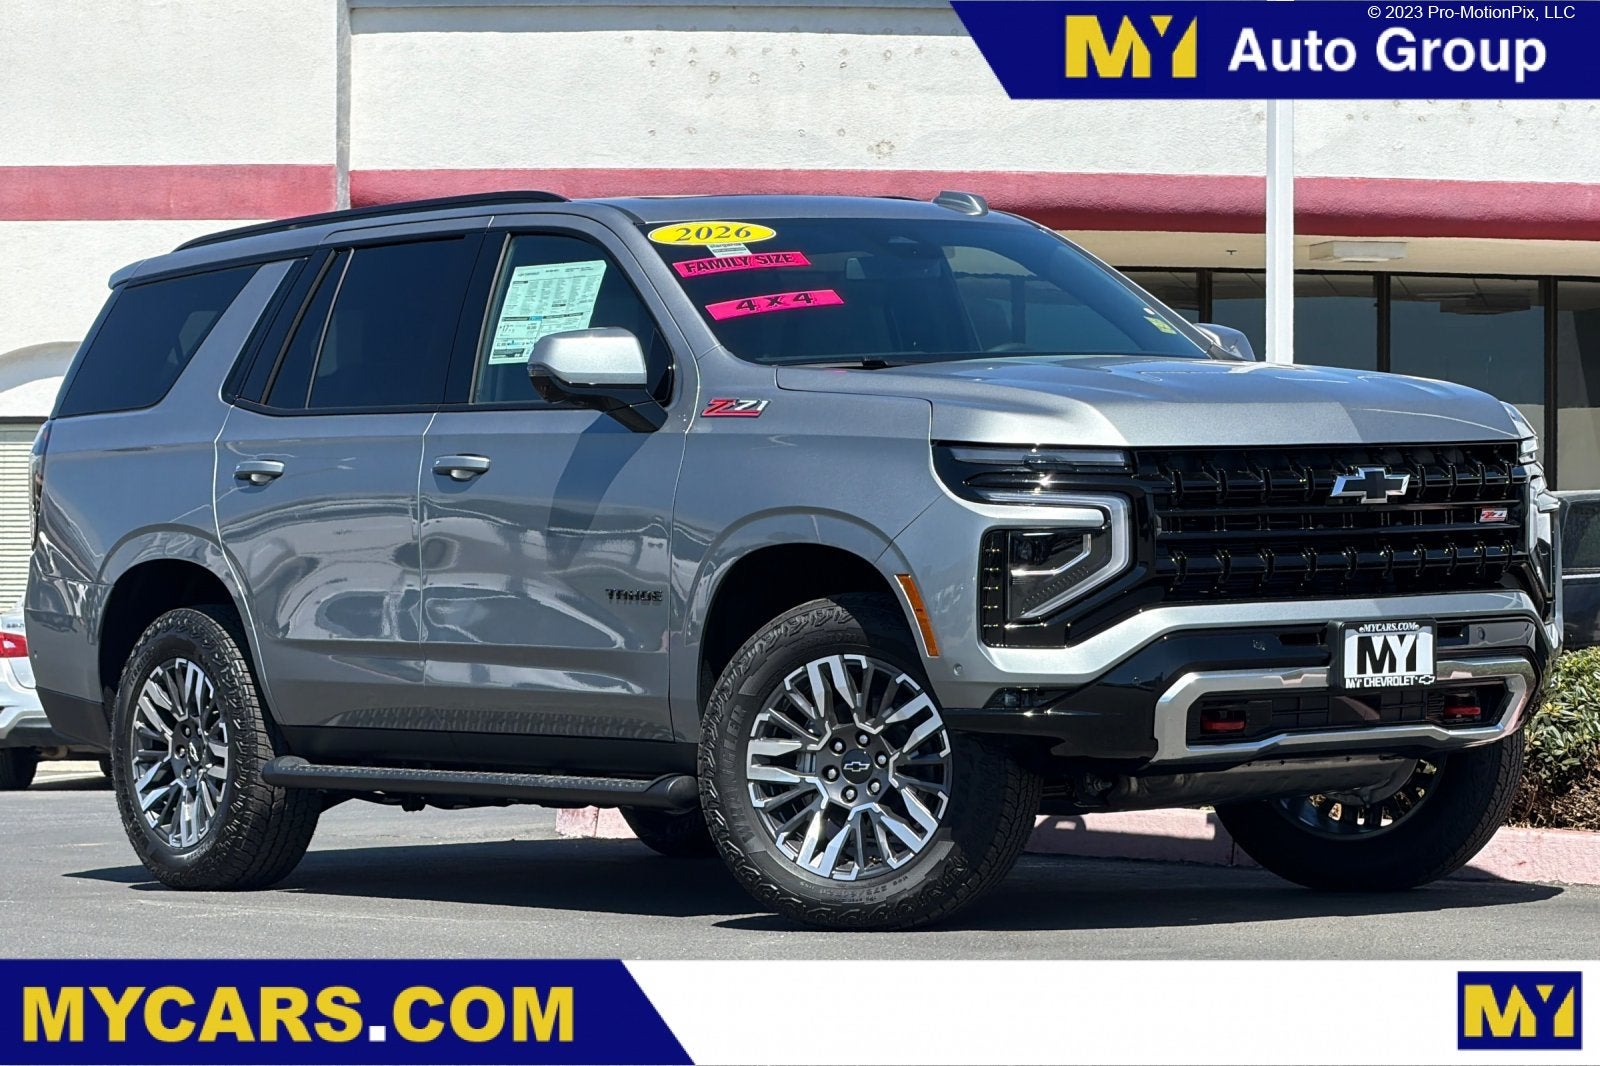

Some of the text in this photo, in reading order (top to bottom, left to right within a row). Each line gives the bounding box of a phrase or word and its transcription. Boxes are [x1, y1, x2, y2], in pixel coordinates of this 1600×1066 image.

[675, 225, 751, 242] 2026
[684, 253, 796, 274] FAMILY SIZE
[701, 397, 771, 418] Z71
[605, 588, 663, 602] TAHOE
[1357, 634, 1417, 675] MY
[1364, 676, 1416, 688] CHEVROLET
